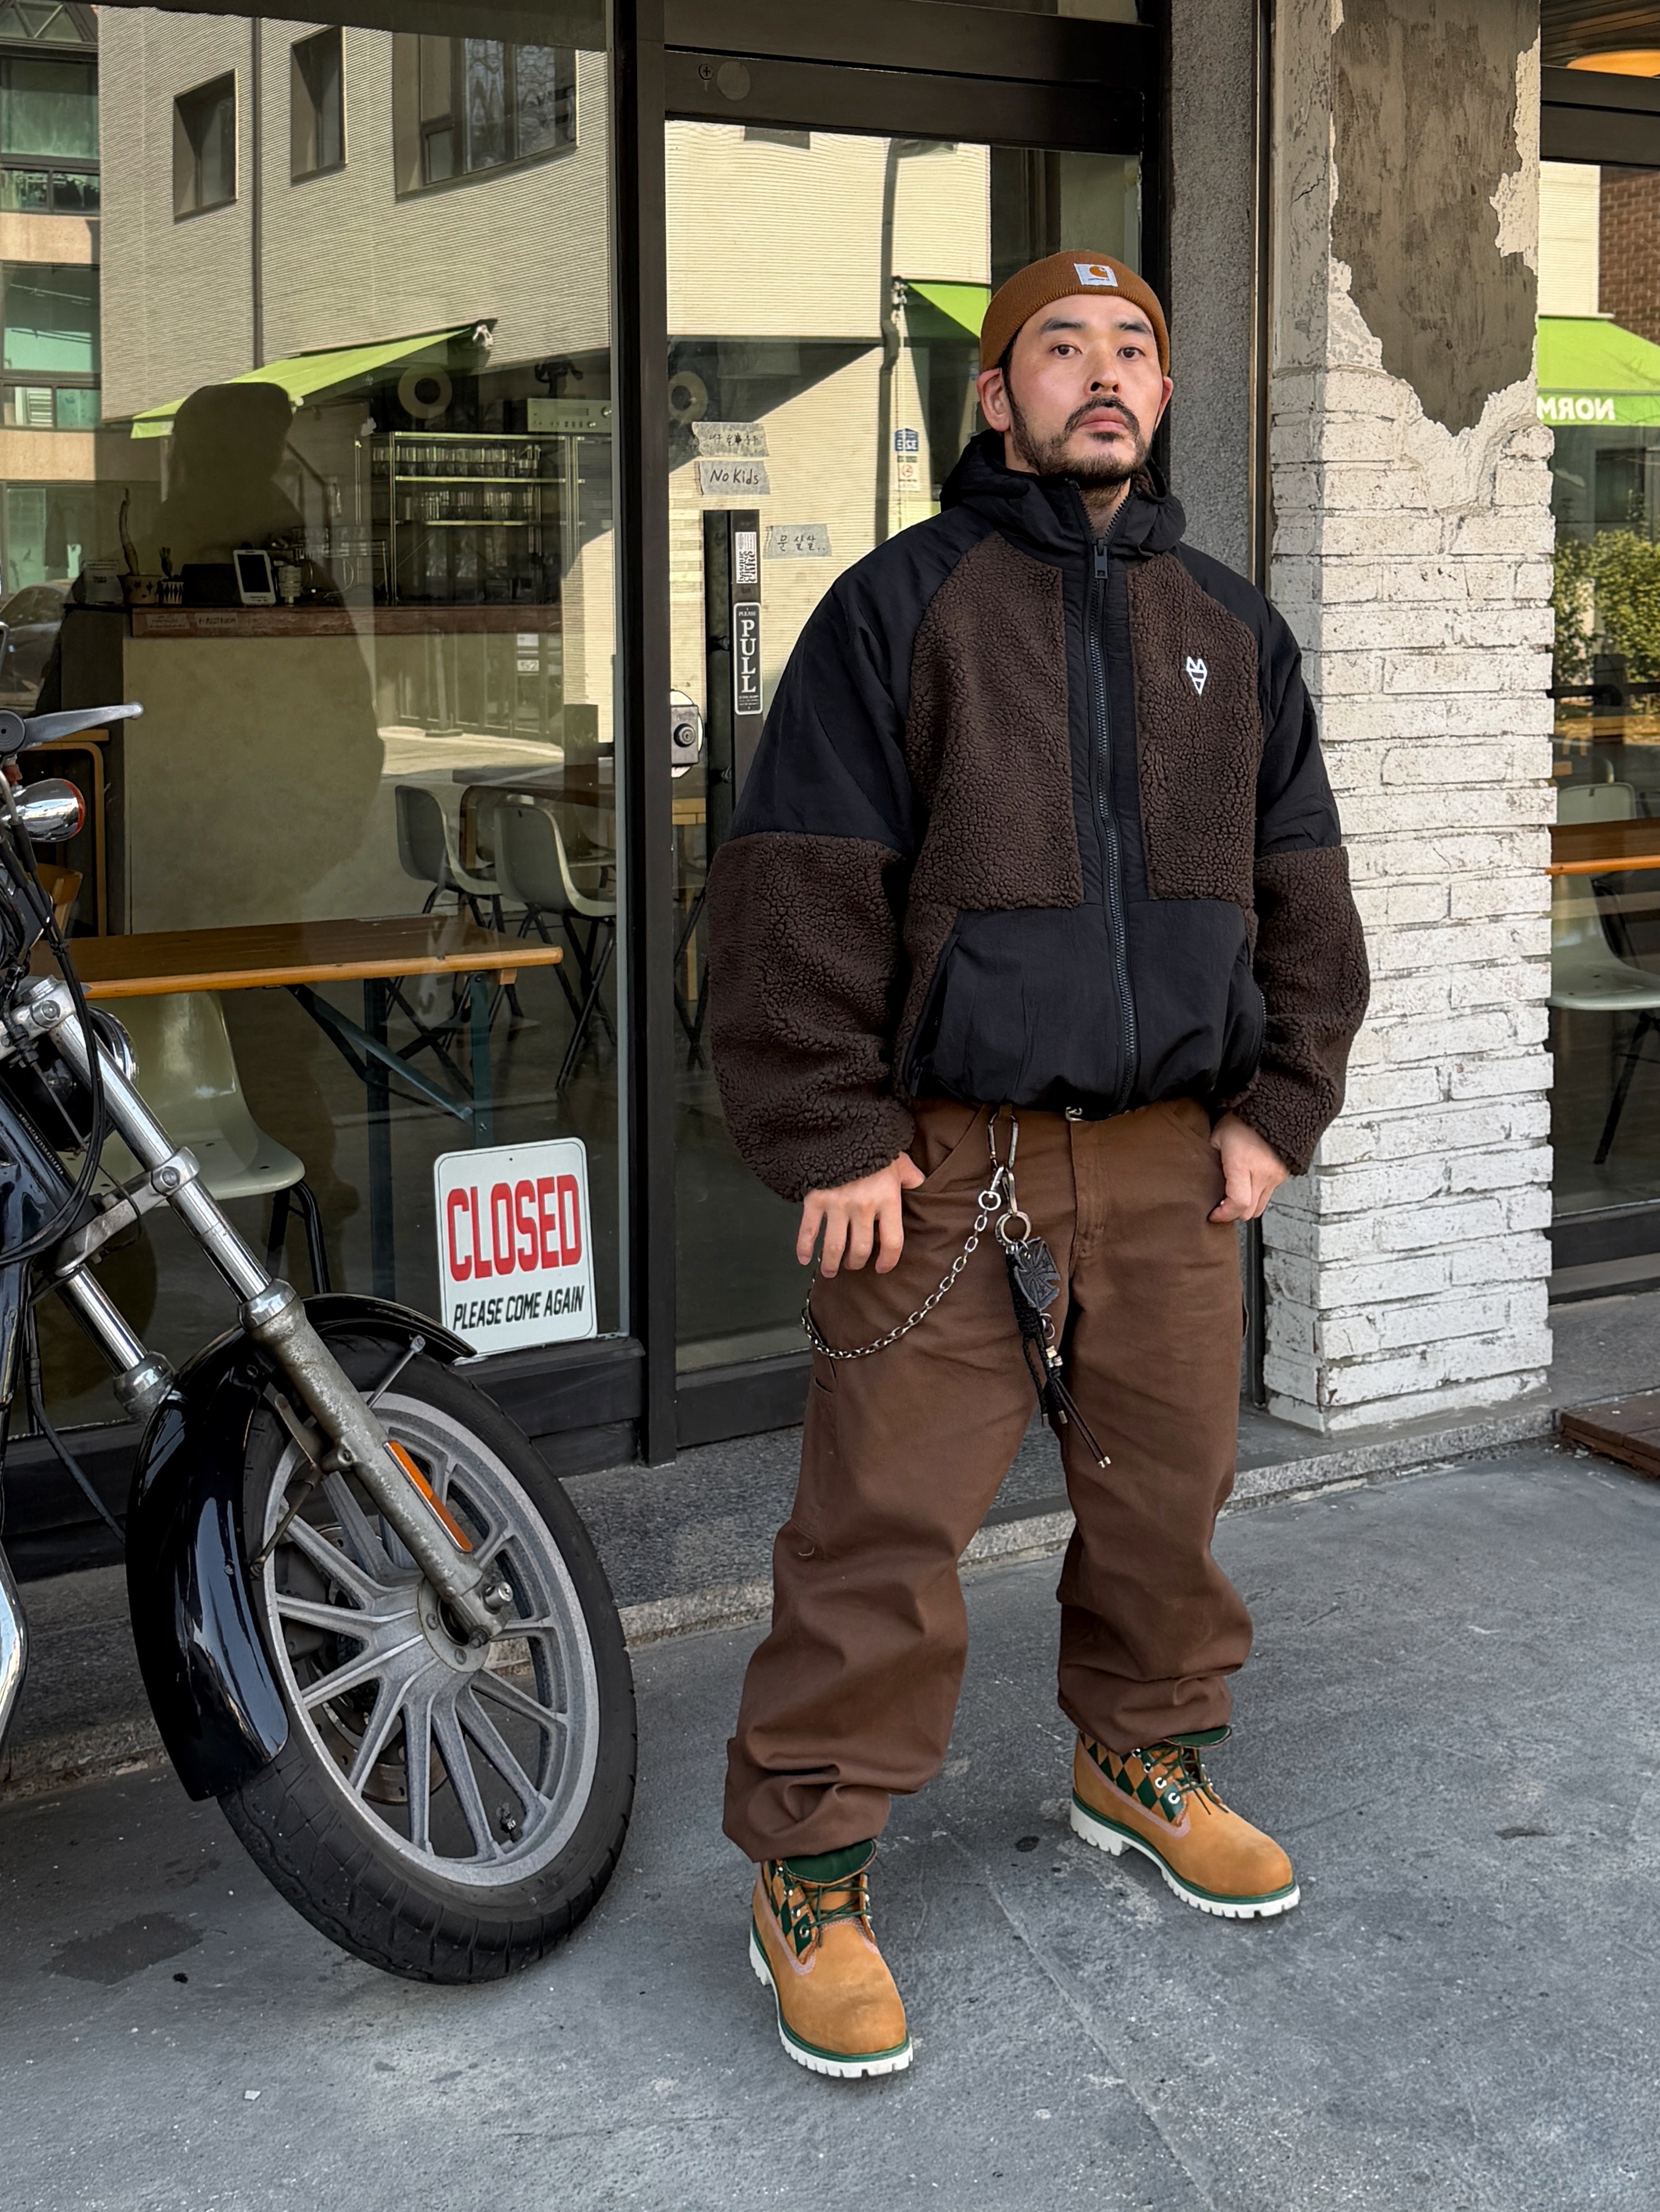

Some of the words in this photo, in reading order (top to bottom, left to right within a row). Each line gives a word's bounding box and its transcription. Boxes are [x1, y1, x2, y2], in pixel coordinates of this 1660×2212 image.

[710, 469, 729, 483] No
[733, 467, 759, 485] Kids
[777, 535, 788, 552] 문
[740, 619, 757, 693] PULL
[447, 1174, 582, 1282] CLOSED
[453, 1298, 503, 1330] PLEASE
[505, 1292, 542, 1323] COME
[544, 1286, 585, 1317] AGAIN
